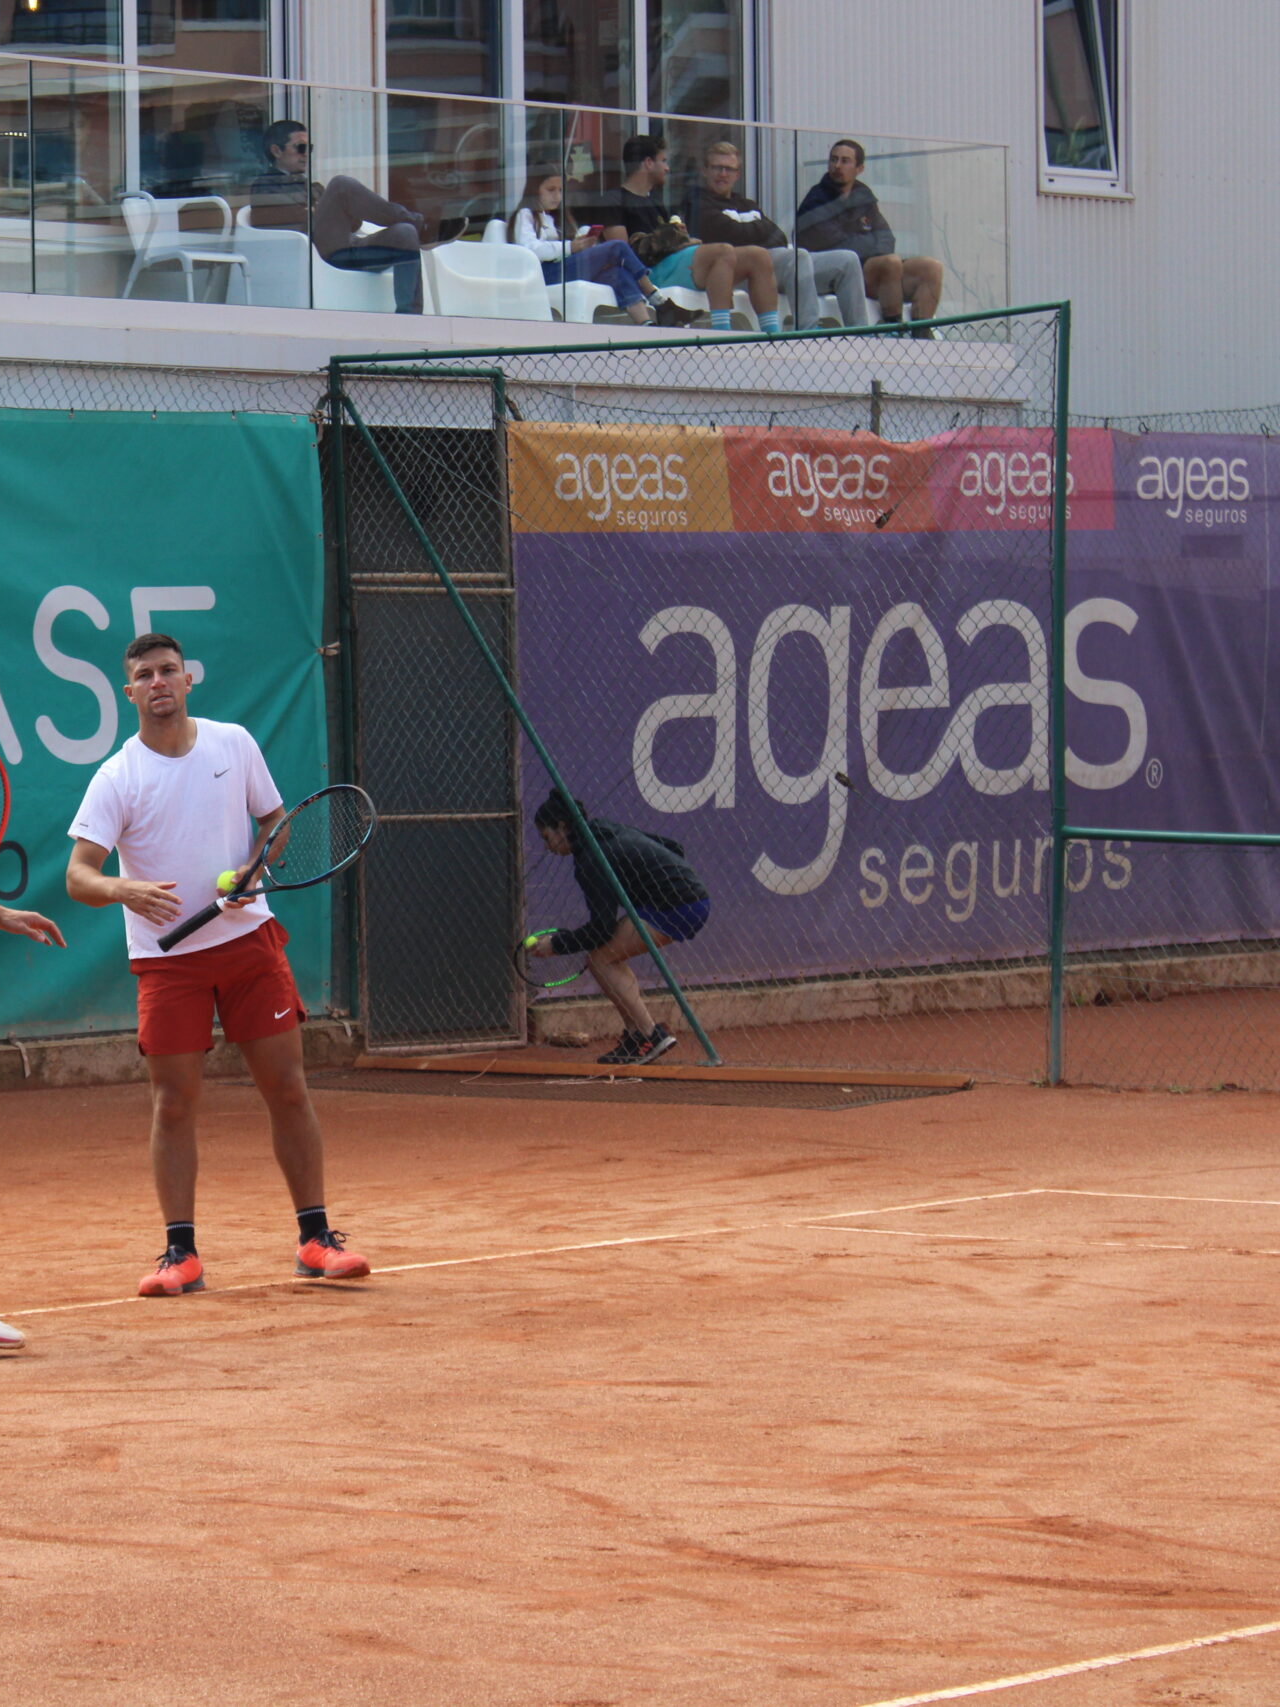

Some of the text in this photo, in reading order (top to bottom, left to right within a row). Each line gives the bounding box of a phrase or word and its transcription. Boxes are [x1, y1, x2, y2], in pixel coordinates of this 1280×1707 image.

[554, 452, 688, 521] ageas
[766, 451, 891, 517] ageas
[1008, 505, 1072, 524] segus
[1136, 456, 1250, 518] ageas
[616, 508, 688, 530] seguros
[1184, 508, 1248, 528] seguros
[632, 597, 1149, 896] ageas
